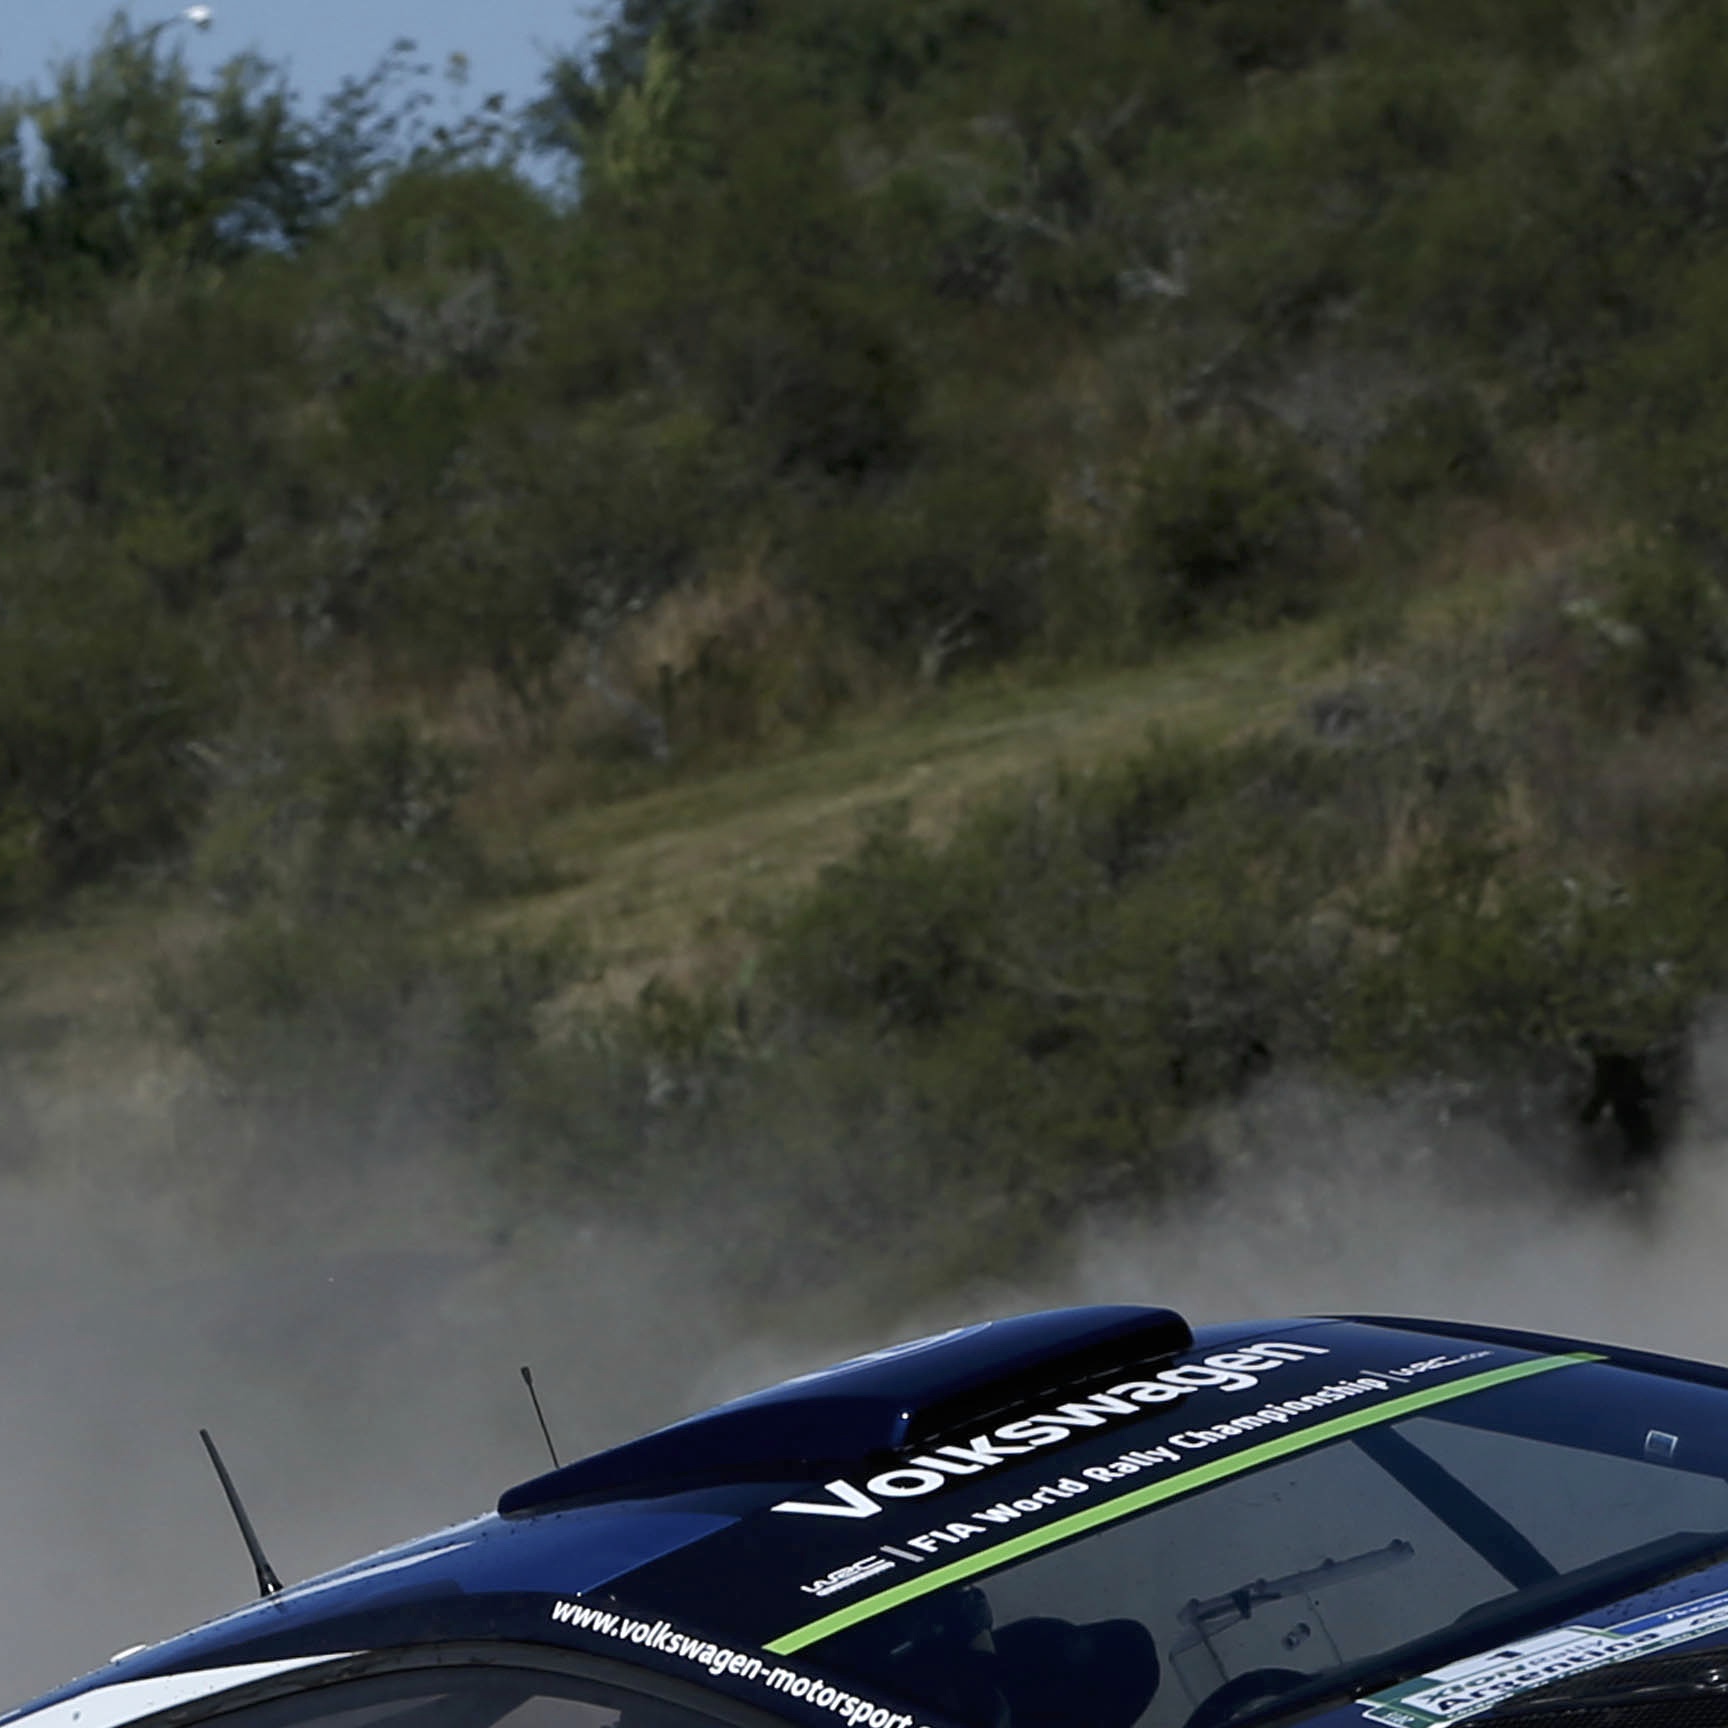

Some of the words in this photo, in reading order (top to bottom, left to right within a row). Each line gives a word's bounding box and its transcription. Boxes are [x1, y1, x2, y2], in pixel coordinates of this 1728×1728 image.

[771, 1342, 1330, 1519] Volkswagen
[908, 1521, 987, 1553] FIA
[971, 1477, 1089, 1524] World
[1083, 1445, 1181, 1483] Rally
[1168, 1377, 1390, 1449] Championship
[1437, 1632, 1659, 1711] Argentina
